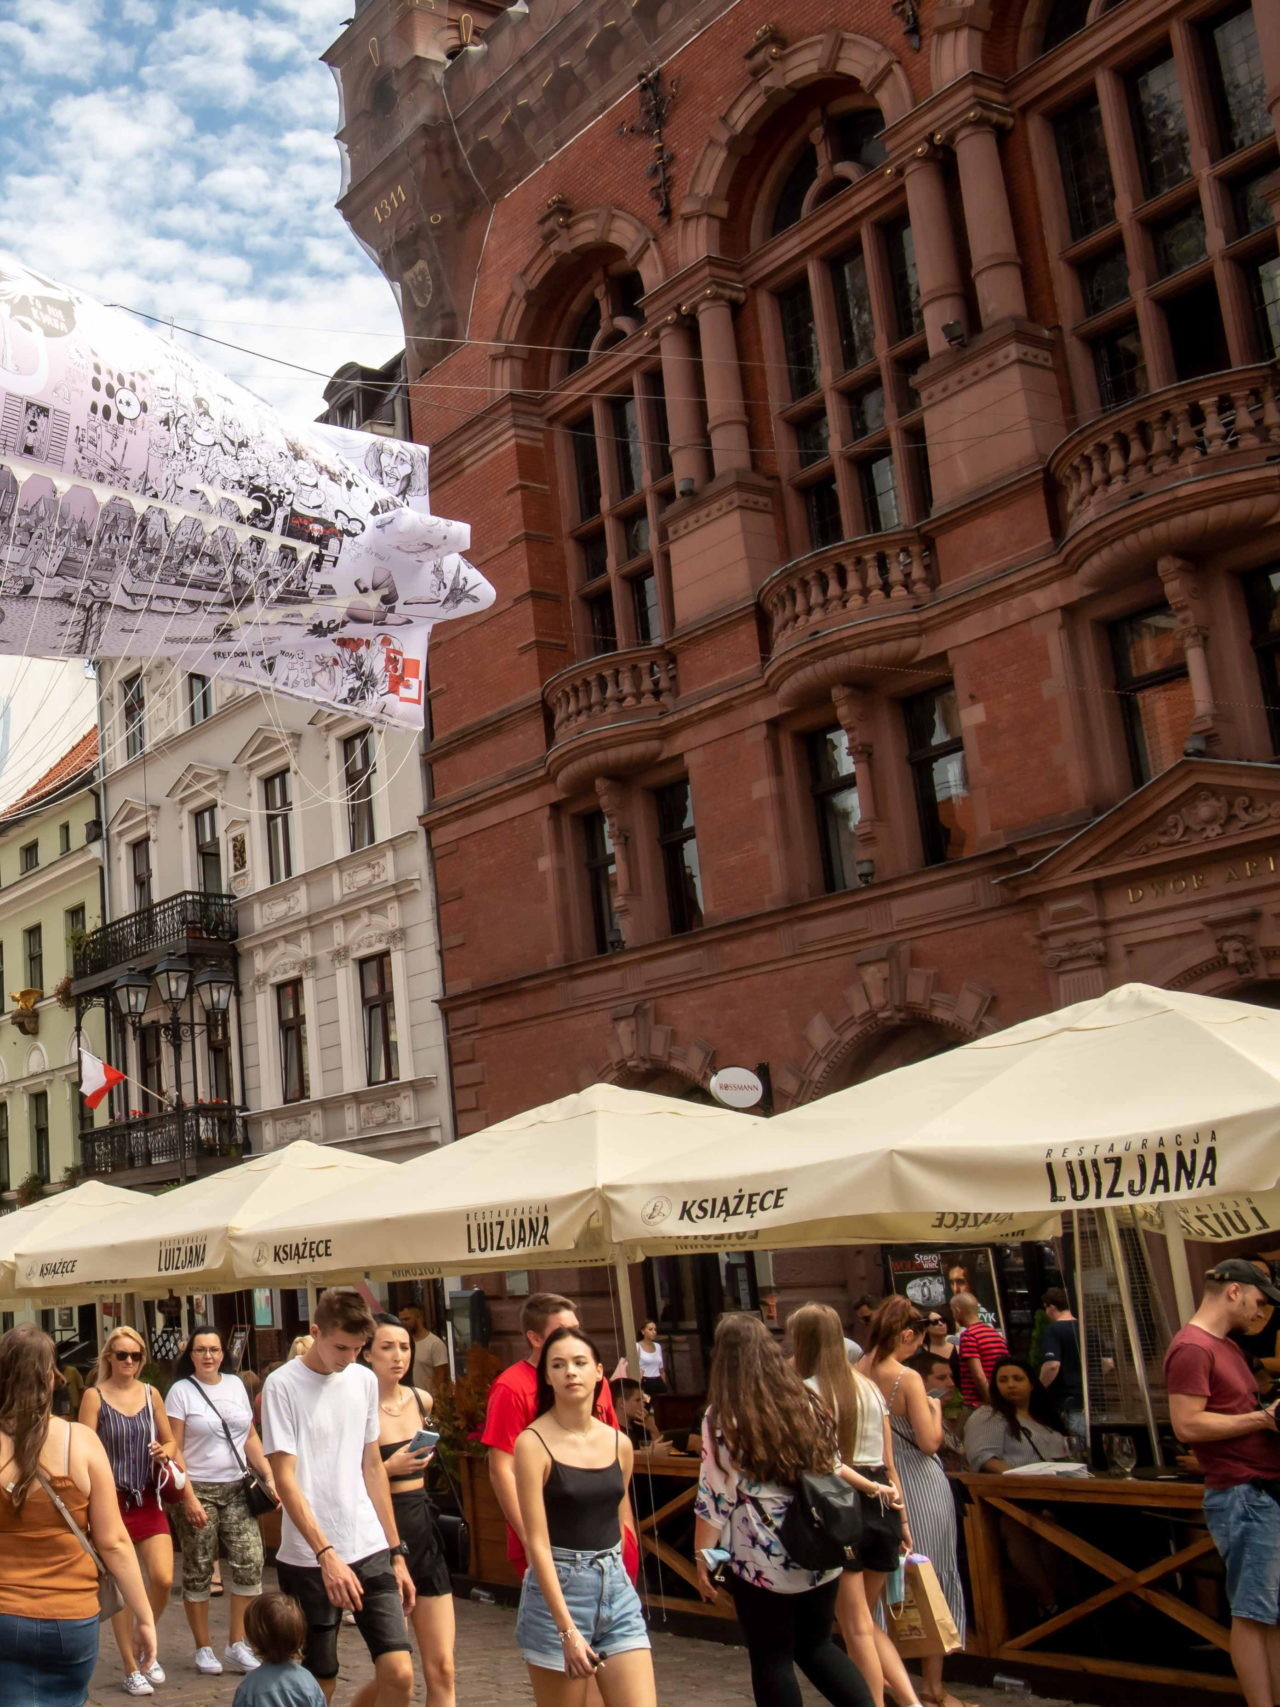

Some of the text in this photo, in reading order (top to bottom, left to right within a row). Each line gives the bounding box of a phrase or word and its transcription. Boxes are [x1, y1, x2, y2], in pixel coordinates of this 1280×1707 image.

[373, 184, 406, 224] 1311
[719, 1083, 759, 1092] ROSSMANN
[1046, 1130, 1217, 1158] RESTAURACJA
[1045, 1146, 1218, 1202] LUIZJANA
[466, 1203, 548, 1222] RESTAURACJA
[678, 1188, 788, 1223] KSIĄŻĘCE
[466, 1215, 550, 1253] LUIZJANA
[158, 1243, 207, 1272] LUIZJANA
[273, 1236, 332, 1264] KSIĄŻĘCE
[40, 1258, 77, 1278] KSIĄŻĘCE
